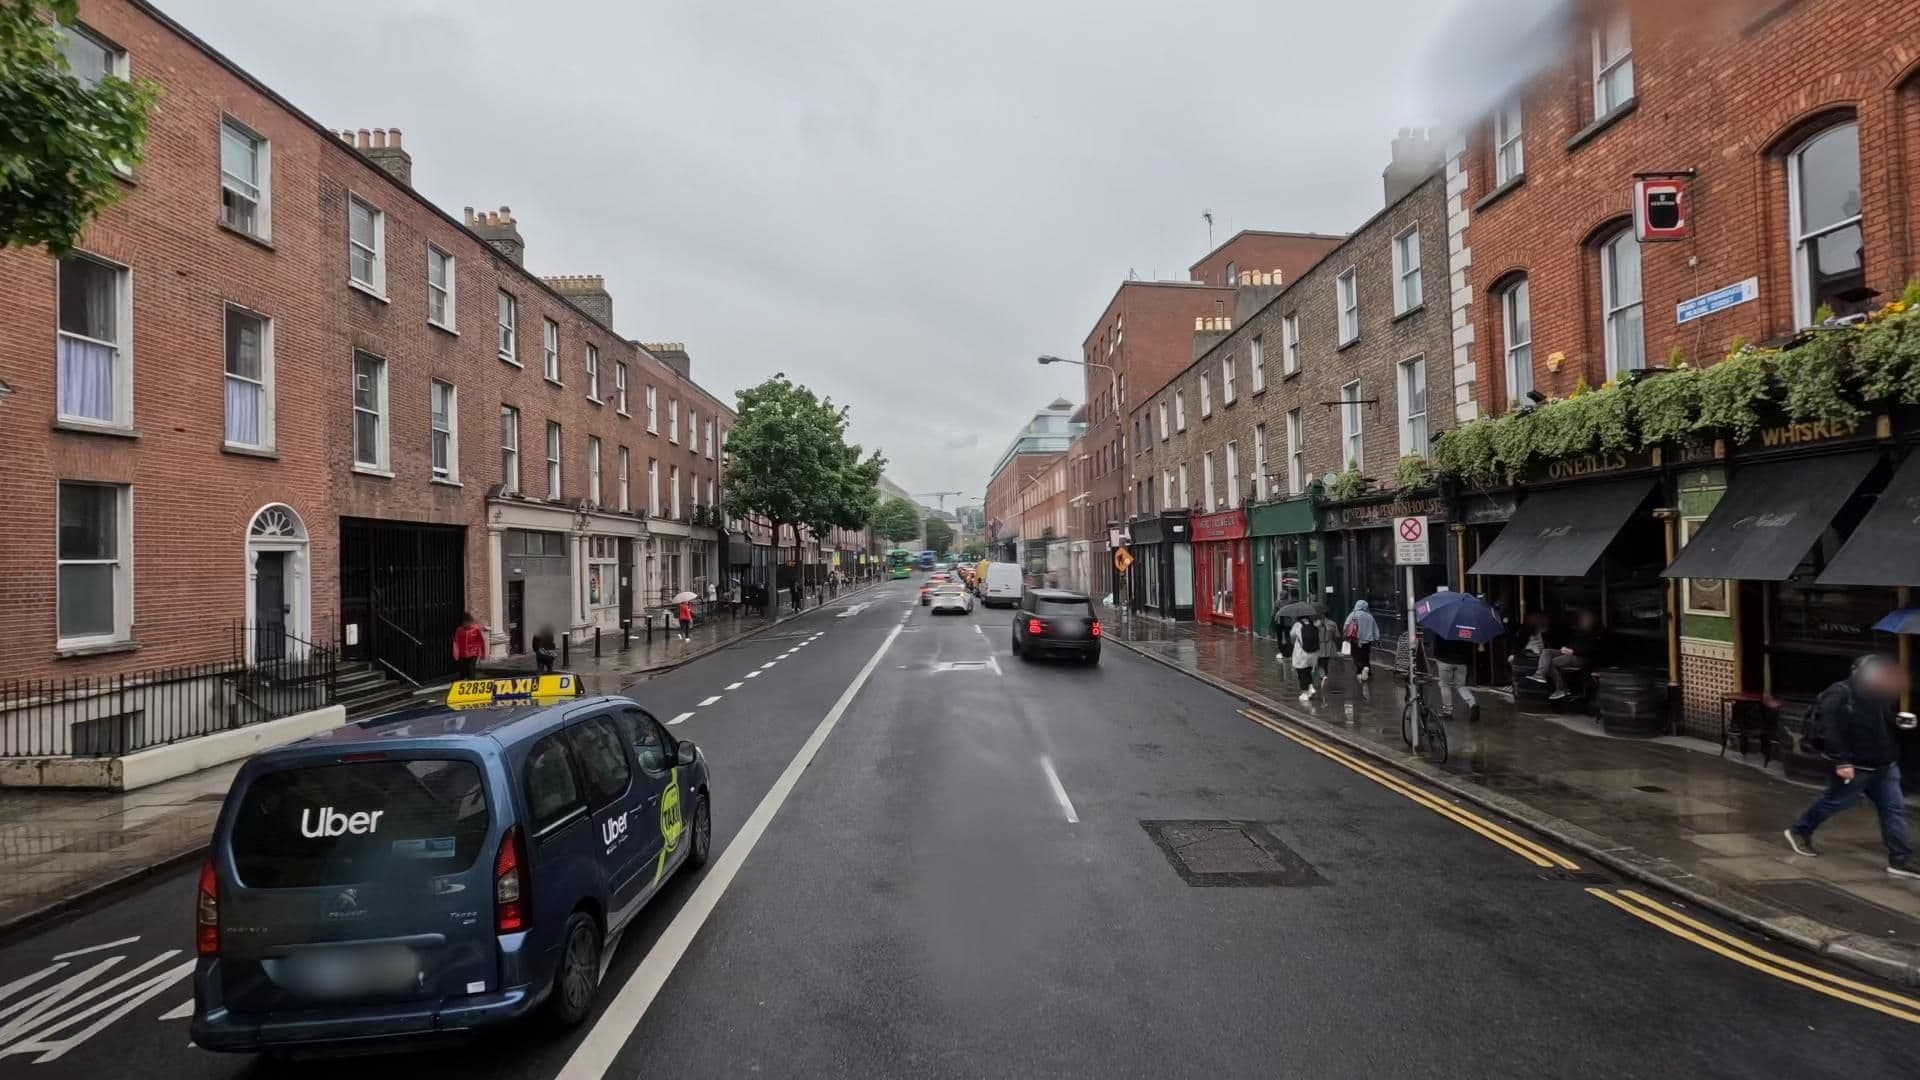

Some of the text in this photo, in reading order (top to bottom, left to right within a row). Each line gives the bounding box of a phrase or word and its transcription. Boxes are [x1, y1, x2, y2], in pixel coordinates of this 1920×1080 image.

[1761, 417, 1857, 446] WHISKEY
[457, 677, 570, 696] 52839 TAXI D
[301, 806, 385, 839] Uber
[602, 811, 629, 846] Uber
[663, 803, 682, 832] TAXI
